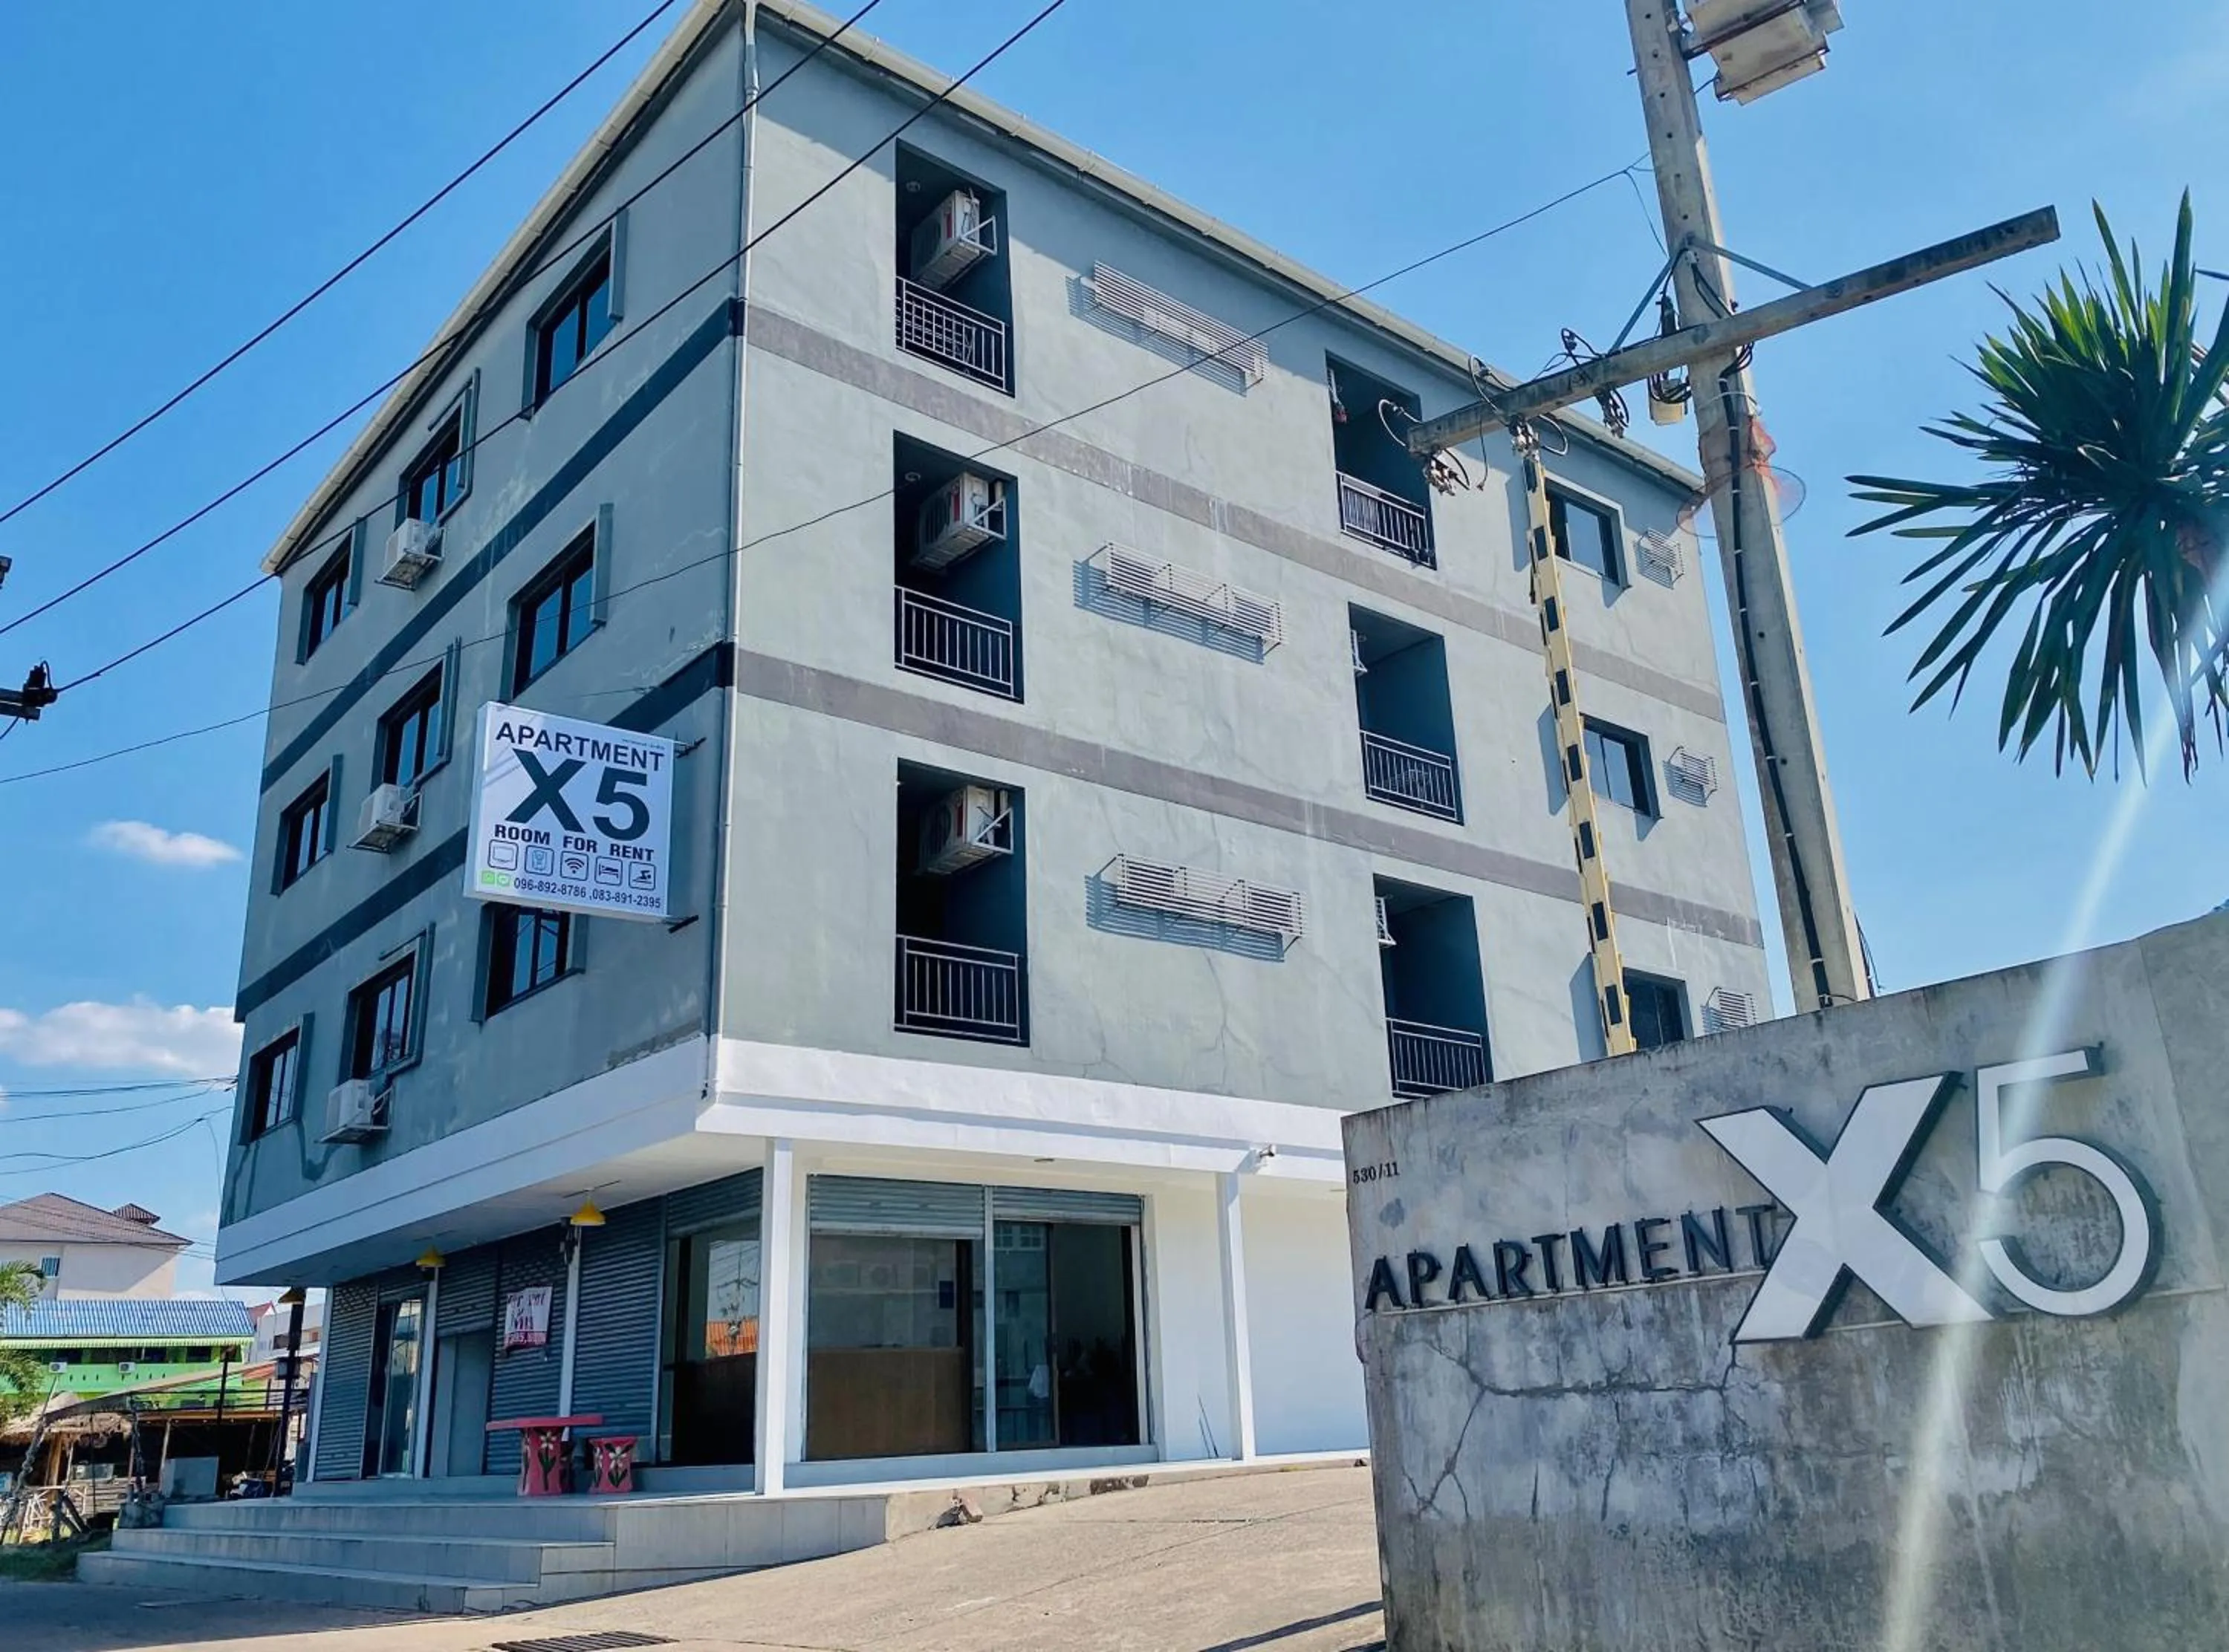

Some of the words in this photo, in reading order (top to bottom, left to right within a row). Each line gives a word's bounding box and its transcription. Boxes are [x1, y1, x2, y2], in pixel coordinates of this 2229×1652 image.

[496, 722, 665, 771] APARTMENT
[505, 748, 649, 841] X5
[495, 825, 551, 846] ROOM
[563, 836, 598, 853] FOR
[610, 843, 655, 862] RENT
[513, 877, 586, 898] 096-892-8786
[1353, 1162, 1400, 1184] 530/11
[1365, 1203, 1777, 1311] APARTMENT
[1695, 1045, 2158, 1344] X5
